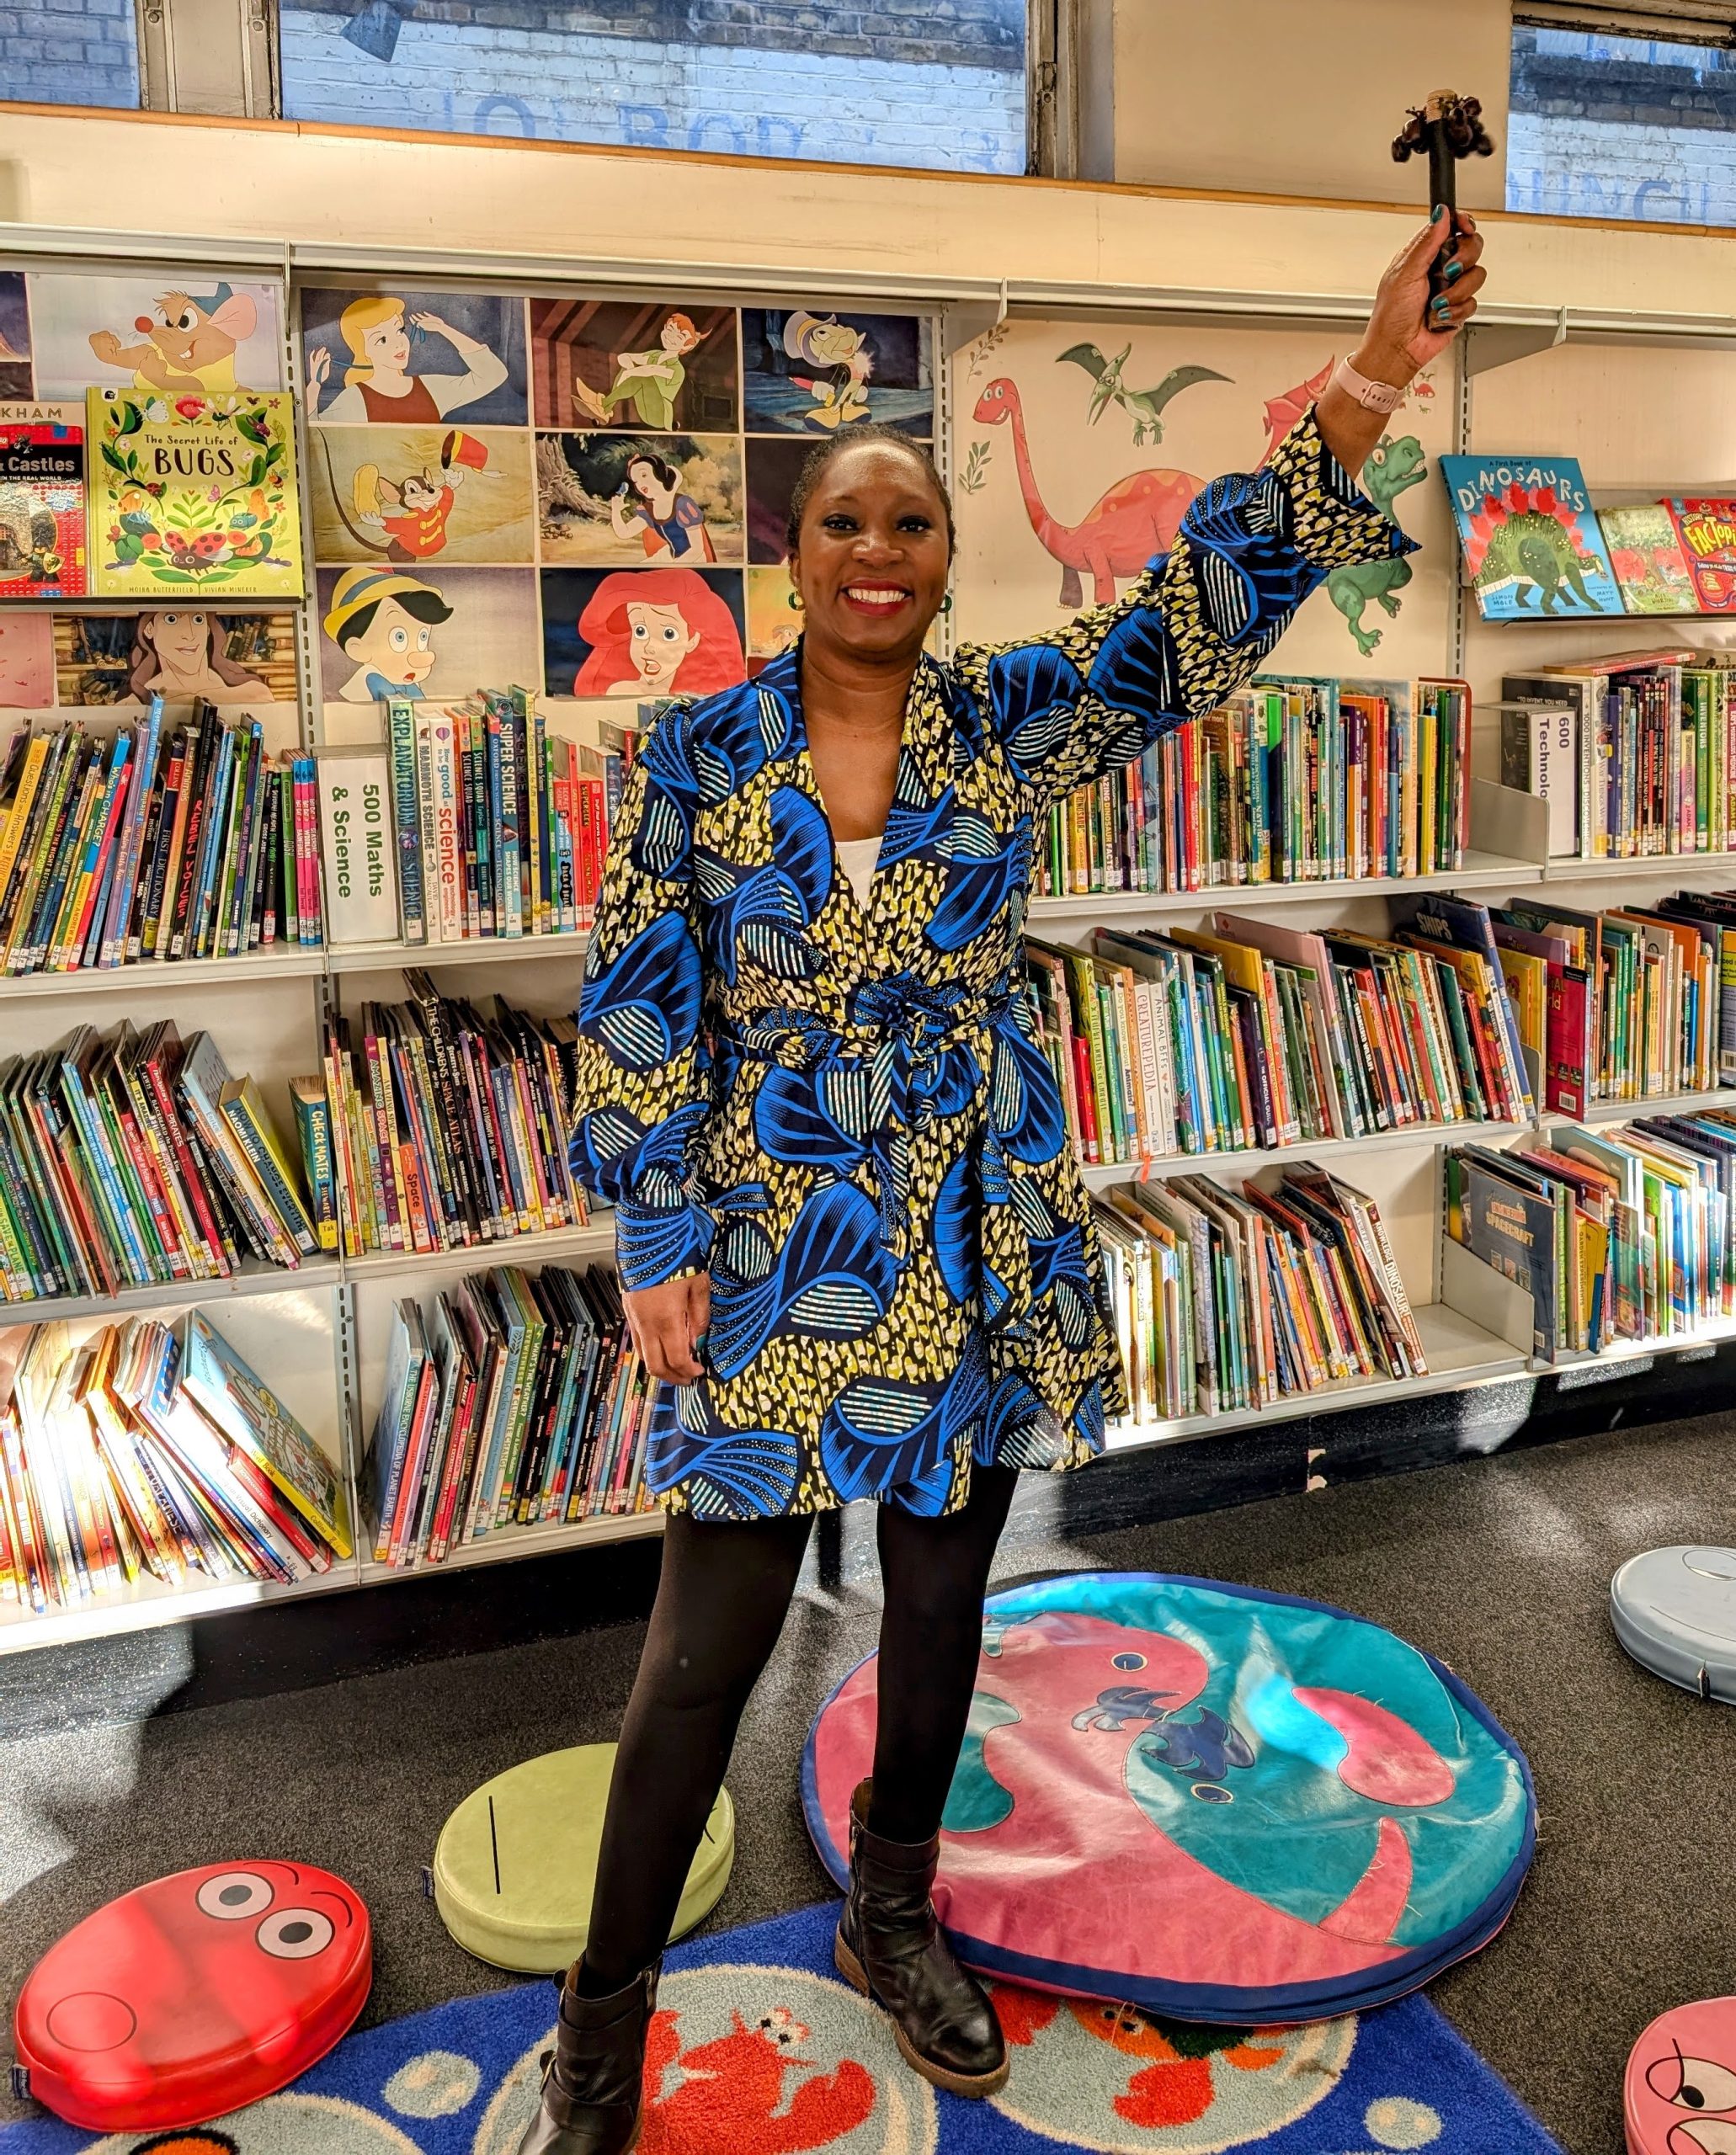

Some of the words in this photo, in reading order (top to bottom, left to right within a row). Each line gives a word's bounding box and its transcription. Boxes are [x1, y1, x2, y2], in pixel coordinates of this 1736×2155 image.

[145, 434, 162, 444] The
[168, 435, 200, 444] Secret
[205, 436, 224, 445] Life
[228, 436, 239, 445] of
[8, 456, 75, 471] Castles
[154, 448, 235, 476] BUGS
[1457, 466, 1585, 512] DINOSAURS
[499, 722, 514, 762] SUPER
[1559, 717, 1569, 748] 600
[171, 762, 180, 787] COLLINS
[392, 708, 414, 826] EXPLANATORIUM
[419, 745, 432, 801] MAMMOTH
[461, 754, 471, 780] SCIENCE
[1539, 718, 1550, 798] Technolo
[19, 764, 38, 803] Questions
[107, 765, 121, 790] Who's
[180, 768, 192, 801] Animals
[331, 786, 349, 801] &
[437, 764, 452, 799] good
[463, 783, 472, 803] SQUAD
[502, 765, 516, 815] SCIENCE
[1102, 774, 1110, 801] AZING
[104, 790, 111, 799] in
[363, 784, 381, 822] 500
[5, 813, 24, 849] Answers
[45, 803, 60, 837] CULTURE
[91, 799, 110, 847] CHARGE?
[422, 805, 434, 849] SCIENCE
[1075, 796, 1084, 833] DINOSAURS
[42, 837, 51, 849] AND
[51, 833, 61, 845] THE
[159, 829, 170, 854] FIRST
[333, 810, 351, 899] Science
[438, 807, 456, 884] science
[35, 849, 46, 874] SPORT
[45, 846, 56, 867] NIGHT
[365, 834, 386, 897] Maths
[38, 867, 51, 893] BEFORE
[149, 857, 166, 916] DICTIONARY
[402, 863, 419, 918] SCIENCE
[33, 893, 43, 913] PRIDE
[1416, 911, 1453, 941] SHIPS
[1116, 992, 1123, 1003] Do
[428, 1006, 439, 1026] THE
[1153, 998, 1165, 1041] ANIMAL
[430, 1026, 449, 1078] CHILDREN'S
[1136, 993, 1157, 1091] CREATUREPEDIA
[1352, 1002, 1367, 1042] ENDANGERED
[1361, 1042, 1374, 1072] WILDLIFE
[1121, 1043, 1130, 1066] about
[1158, 1045, 1169, 1068] BFFS
[369, 1057, 384, 1109] AMAZING
[382, 1078, 393, 1112] AMAZING
[440, 1080, 456, 1115] SPACE
[1123, 1068, 1134, 1106] Animals?
[1260, 1074, 1270, 1104] OFFICIAL
[149, 1099, 168, 1136] BLACKBEARD
[166, 1113, 184, 1147] PIRATES
[312, 1110, 326, 1145] CHECK
[375, 1109, 389, 1144] SPACE
[387, 1113, 397, 1134] SPACE
[226, 1109, 248, 1140] NAOMI
[242, 1138, 261, 1163] KLEIN
[234, 1104, 253, 1131] HOW
[248, 1130, 261, 1146] TO
[256, 1146, 283, 1187] CHANGE
[448, 1117, 464, 1154] ATLAS
[154, 1151, 173, 1189] PIRATES
[168, 1147, 178, 1160] Pirate
[172, 1159, 182, 1172] King
[314, 1146, 328, 1179] MATES
[405, 1172, 422, 1208] Space
[0, 1217, 14, 1242] SAVE
[1374, 1221, 1393, 1263] KNOWLEDGE
[1383, 1261, 1410, 1317] DINOSAUR!
[505, 1358, 517, 1382] Water
[516, 1328, 532, 1381] EYEWITNESS
[528, 1341, 540, 1367] WHAT'S
[408, 1369, 418, 1382] THE
[460, 1378, 470, 1405] EDGE
[525, 1368, 535, 1382] THE
[403, 1383, 415, 1413] USBORNE
[445, 1383, 455, 1403] EARTH
[499, 1384, 512, 1410] Cycles
[519, 1381, 533, 1416] WEATHER?
[442, 1406, 451, 1425] ROCKS
[505, 1397, 519, 1434] CLIMATE
[583, 1411, 594, 1439] Earthquakes
[394, 1413, 410, 1460] ENCYCLOPEDIA
[262, 1461, 276, 1477] Book
[392, 1461, 402, 1470] OF
[498, 1436, 511, 1471] CHANGE
[388, 1470, 400, 1495] PLANET
[384, 1496, 395, 1518] EARTH
[248, 1510, 274, 1540] Dictionary
[309, 1514, 327, 1534] Collins
